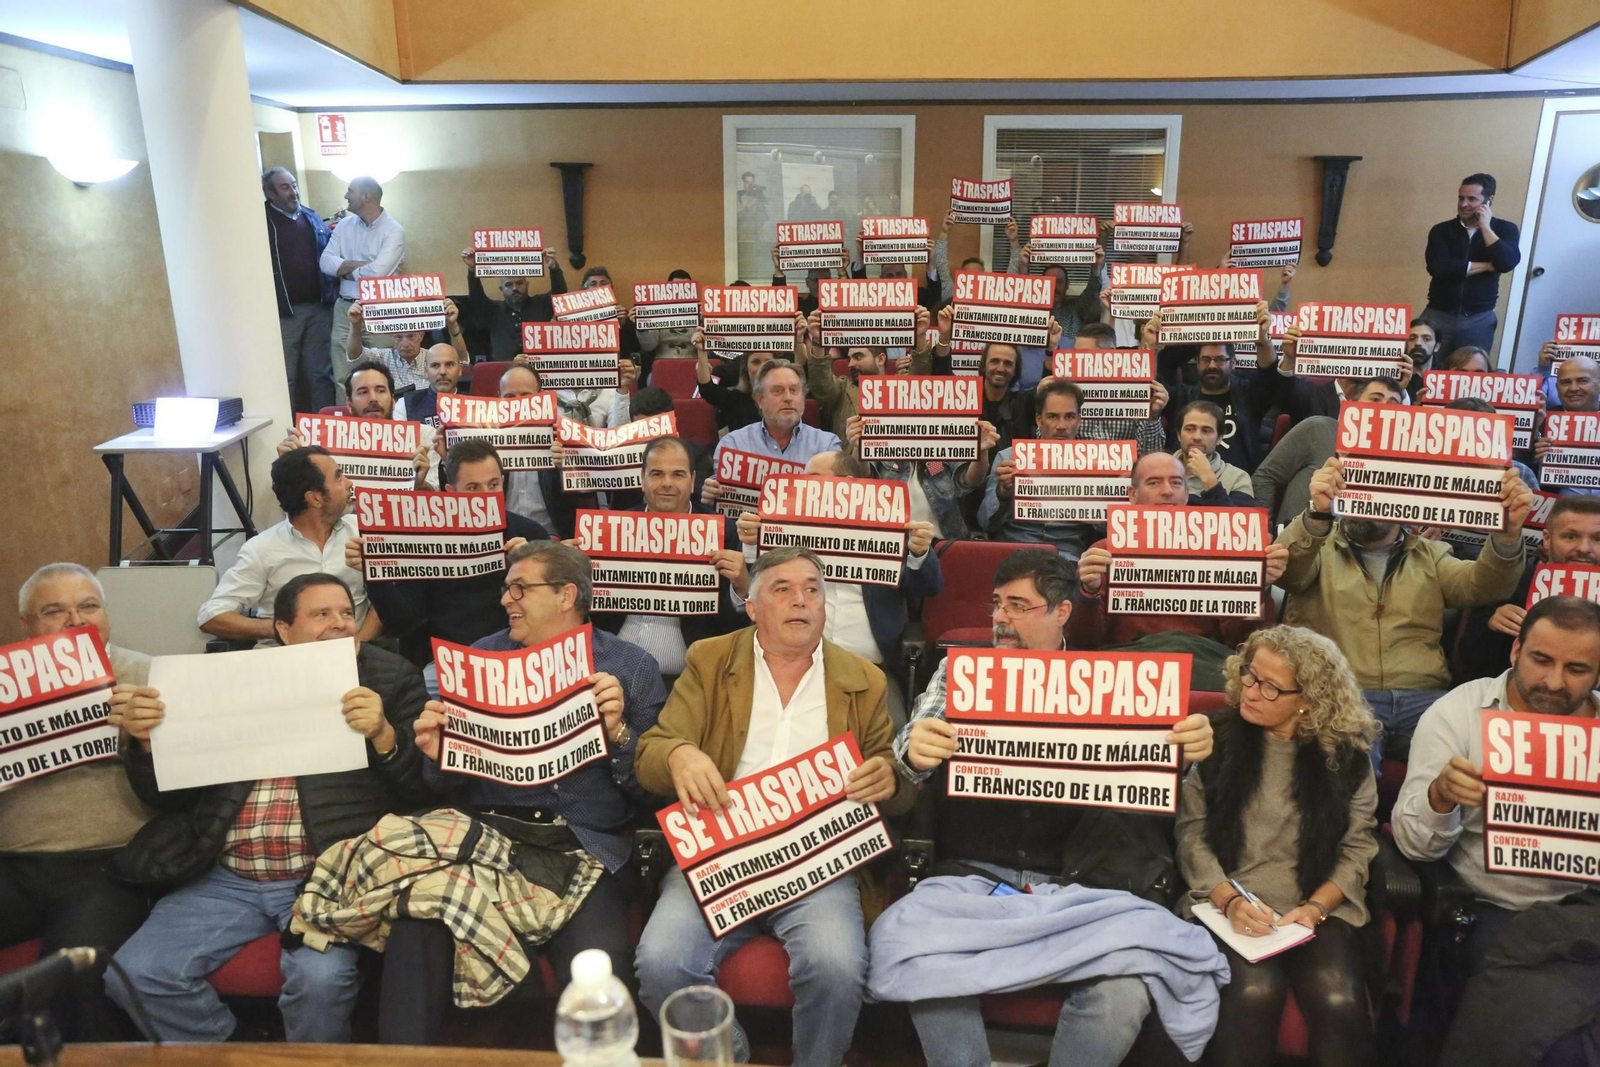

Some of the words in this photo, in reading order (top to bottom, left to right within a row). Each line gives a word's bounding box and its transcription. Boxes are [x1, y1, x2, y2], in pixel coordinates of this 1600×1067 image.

[952, 178, 962, 196] SE
[963, 181, 1010, 200] TRASPASA
[1032, 218, 1043, 234] SE
[1045, 218, 1096, 234] TRASPASA
[1115, 206, 1127, 223] SE
[1129, 206, 1180, 223] TRASPASA
[474, 231, 487, 248] SE
[489, 230, 541, 248] TRASPASA
[778, 226, 790, 242] SE
[792, 223, 842, 242] TRASPASA
[862, 220, 875, 236] SE
[876, 220, 927, 236] TRASPASA
[1232, 224, 1245, 241] SE
[1247, 220, 1300, 240] TRASPASA
[360, 280, 376, 299] SE
[378, 276, 442, 298] TRASPASA
[634, 285, 646, 301] SE
[648, 283, 697, 301] TRASPASA
[821, 282, 838, 307] SE
[841, 282, 914, 307] TRASPASA
[956, 274, 974, 299] SE
[976, 275, 1050, 304] TRASPASA
[1162, 275, 1179, 301] SE
[1182, 272, 1259, 300] TRASPASA
[552, 295, 566, 313] SE
[565, 287, 615, 311] TRASPASA
[704, 290, 721, 312] SE
[723, 290, 794, 312] TRASPASA
[824, 319, 873, 327] AYUNTAMIENTO
[875, 319, 883, 327] DE
[885, 317, 912, 327] MÁLAGA
[1299, 305, 1319, 331] SE
[1322, 306, 1406, 334] TRASPASA
[1558, 318, 1576, 340] SE
[525, 327, 542, 349] SE
[544, 326, 616, 349] TRASPASA
[1054, 353, 1072, 378] SE
[1076, 352, 1151, 378] TRASPASA
[862, 379, 882, 410] SE
[887, 380, 978, 410] TRASPASA
[1425, 379, 1446, 402] SE
[1449, 380, 1537, 406] TRASPASA
[440, 397, 460, 423] SE
[465, 395, 553, 424] TRASPASA
[300, 417, 321, 447] SE
[325, 420, 416, 453] TRASPASA
[560, 419, 580, 443] SE
[584, 415, 673, 447] TRASPASA
[864, 425, 926, 435] AYUNTAMIENTO
[929, 425, 939, 434] DE
[941, 423, 975, 435] MÁLAGA
[1342, 406, 1374, 449] SE
[1379, 410, 1507, 460] TRASPASA
[1548, 416, 1567, 440] SE
[864, 447, 872, 457] D.
[874, 447, 921, 457] FRANCISCO
[924, 448, 934, 457] DE
[937, 448, 946, 457] LA
[948, 447, 975, 457] TORRE
[1016, 444, 1035, 471] SE
[1040, 444, 1132, 471] TRASPASA
[1344, 460, 1366, 468] RAZÓN:
[1434, 477, 1449, 490] DE
[1452, 476, 1502, 495] MÁLAGA
[359, 492, 386, 526] SE
[387, 495, 502, 528] TRASPASA
[762, 478, 788, 515] SE
[793, 480, 906, 524] TRASPASA
[1337, 499, 1348, 513] D.
[1351, 501, 1419, 519] FRANCISCO
[1423, 507, 1438, 521] DE
[1441, 509, 1454, 522] LA
[1459, 510, 1499, 526] TORRE
[578, 514, 603, 551] SE
[608, 516, 719, 556] TRASPASA
[1111, 510, 1138, 548] SE
[1143, 511, 1262, 551] TRASPASA
[367, 542, 442, 553] AYUNTAMIENTO
[446, 543, 457, 553] DE
[460, 540, 501, 554] MÁLAGA
[370, 567, 380, 578] D.
[382, 566, 439, 577] FRANCISCO
[443, 566, 455, 576] DE
[458, 565, 469, 576] LA
[471, 559, 503, 574] TORRE
[660, 572, 671, 584] DE
[674, 571, 715, 586] MÁLAGA
[1113, 568, 1194, 582] AYUNTAMIENTO
[1198, 571, 1211, 583] DE
[1214, 568, 1257, 584] MÁLAGA
[593, 597, 653, 610] FRANCISCO
[654, 599, 665, 611] DE
[668, 600, 680, 612] LA
[683, 601, 715, 612] TORRE
[1112, 598, 1122, 611] D.
[1125, 598, 1186, 612] FRANCISCO
[1190, 600, 1203, 612] DE
[1207, 600, 1219, 613] LA
[1222, 600, 1256, 614] TORRE
[1113, 590, 1145, 598] CONTACTO:
[437, 645, 468, 698] SE
[469, 632, 590, 706] TRASPASA
[953, 655, 994, 712] SE
[1002, 657, 1180, 717] TRASPASA
[25, 720, 47, 738] DE
[48, 701, 111, 731] MÁLAGA
[448, 716, 540, 746] AYUNTAMIENTO
[544, 722, 557, 741] DE
[559, 702, 594, 734] MÁLAGA
[958, 728, 988, 737] RAZÓN:
[27, 754, 50, 773] DE
[51, 749, 72, 766] LA
[72, 736, 117, 759] TORRE
[448, 741, 483, 757] CONTACTO:
[956, 738, 1077, 760] AYUNTAMIENTO
[1082, 743, 1102, 761] DE
[1106, 741, 1171, 763] MÁLAGA
[1488, 717, 1532, 776] SE
[447, 751, 459, 767] D.
[463, 754, 534, 782] FRANCISCO
[539, 763, 554, 780] DE
[557, 758, 569, 774] LA
[570, 738, 602, 766] TORRE
[955, 765, 1002, 776] CONTACTO:
[955, 775, 968, 792] D.
[974, 776, 1064, 798] FRANCISCO
[1070, 782, 1089, 800] DE
[1094, 784, 1112, 802] LA
[1117, 785, 1170, 807] TORRE
[666, 804, 715, 859] SE
[699, 842, 800, 896] AYUNTAMIENTO
[801, 831, 820, 851] DE
[819, 803, 873, 841] MÁLAGA
[696, 862, 722, 880] RAZÓN:
[714, 914, 730, 930] D.
[730, 877, 807, 923] FRANCISCO
[808, 867, 826, 885] DE
[826, 858, 843, 876] LA
[843, 833, 887, 866] TORRE
[710, 890, 750, 914] CONTACTO:
